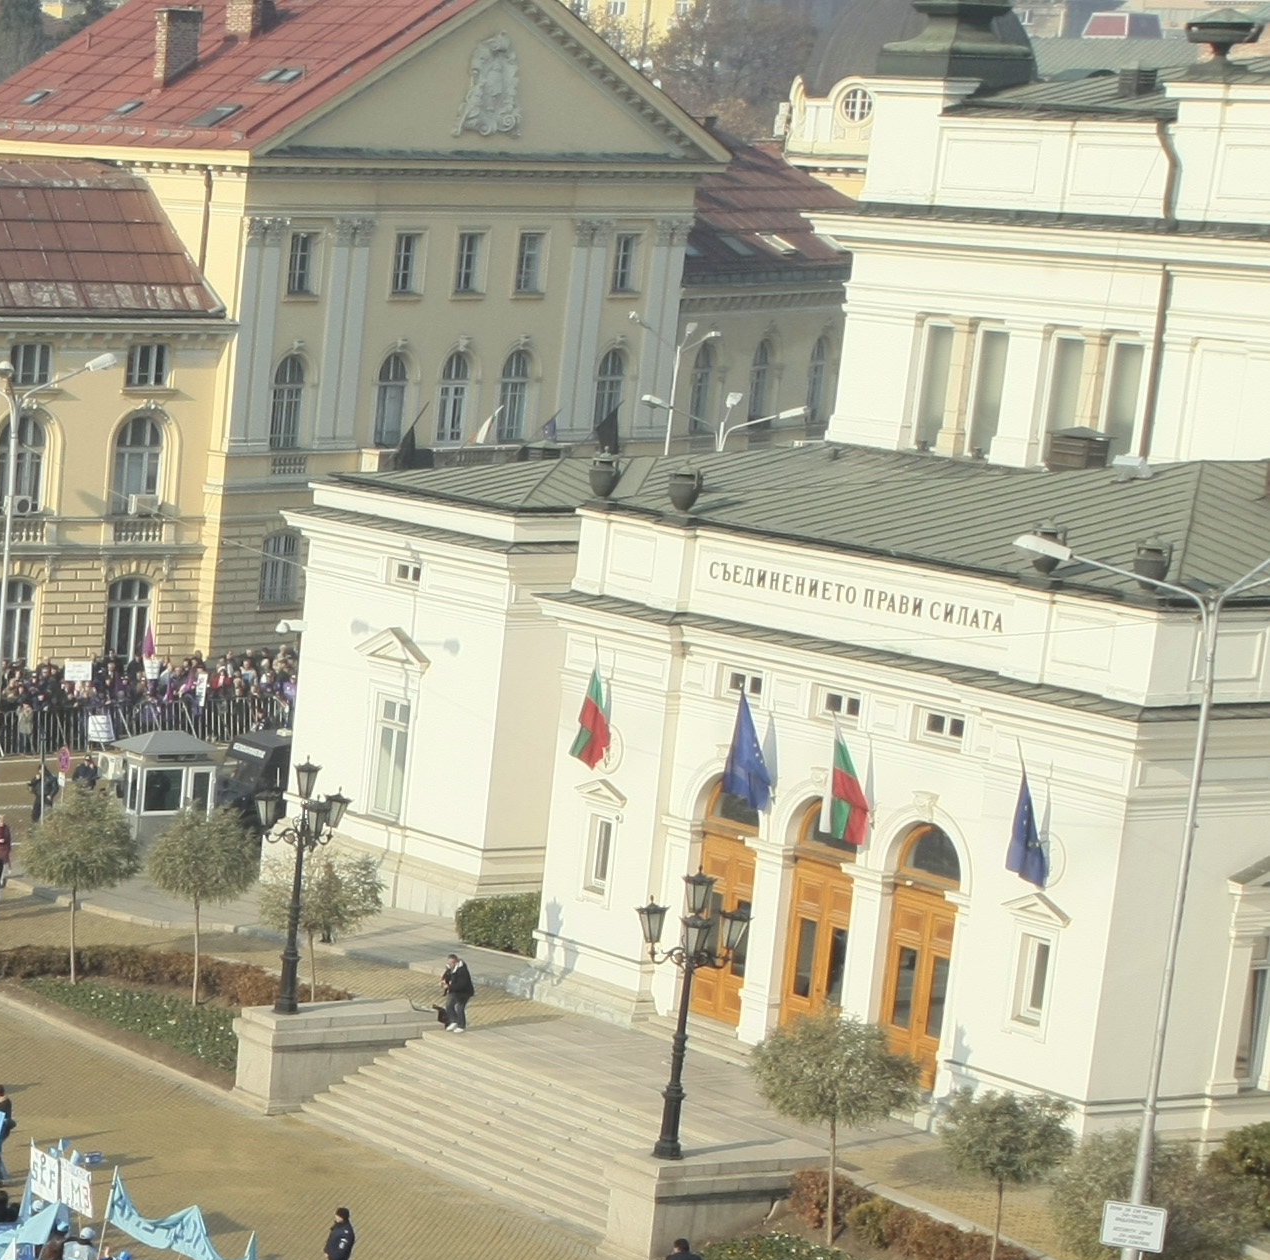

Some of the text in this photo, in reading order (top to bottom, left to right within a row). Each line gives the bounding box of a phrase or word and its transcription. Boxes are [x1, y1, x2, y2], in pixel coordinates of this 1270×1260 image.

[710, 561, 1004, 633] СЪЕДИНЕНИЕТО ПРАВИ СИЛАТА
